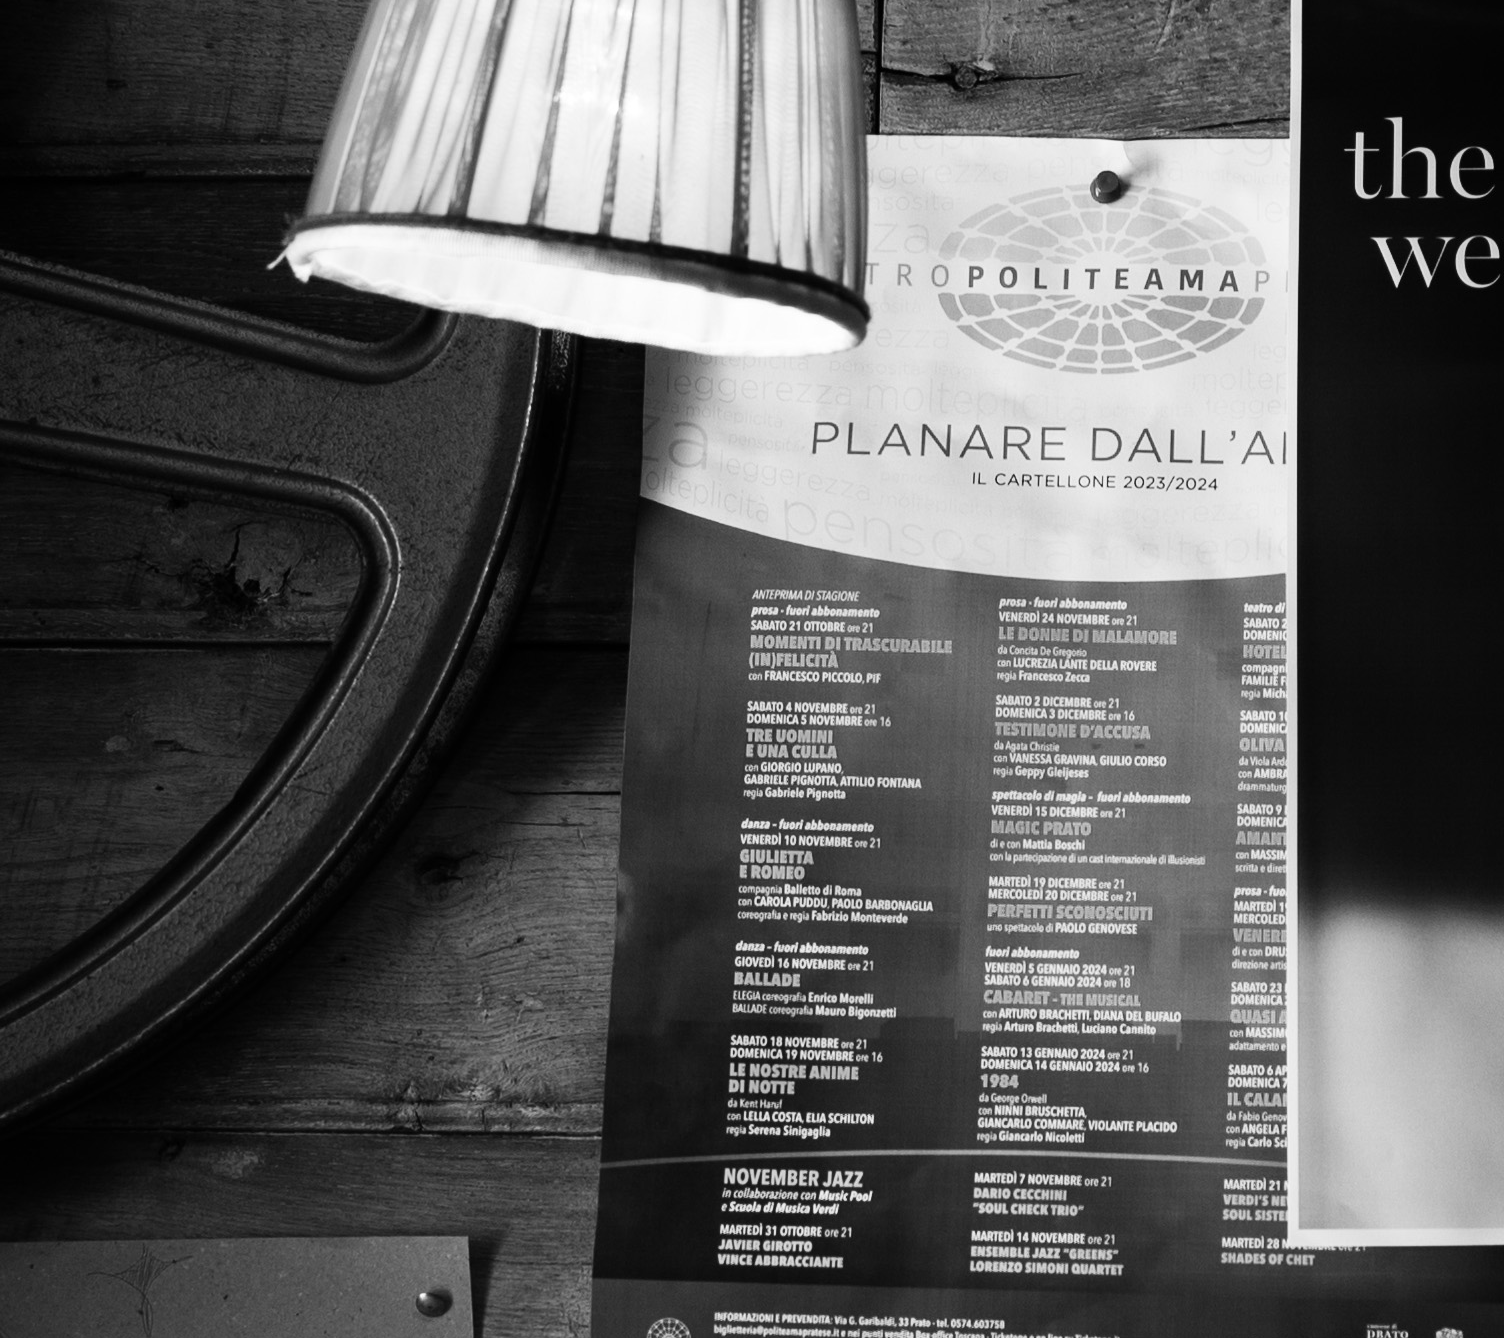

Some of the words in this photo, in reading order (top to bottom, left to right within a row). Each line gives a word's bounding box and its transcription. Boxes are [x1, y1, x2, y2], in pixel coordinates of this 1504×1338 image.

[1343, 116, 1495, 200] the
[1370, 235, 1501, 289] we
[811, 421, 1066, 461] PLANARE
[1091, 427, 1287, 465] DALL'A
[972, 471, 987, 486] IL
[994, 472, 1116, 489] CARTELLONE
[1123, 475, 1218, 492] 2023/2024
[751, 589, 803, 601] ANTEPRIMA
[804, 589, 816, 601] DI
[815, 589, 861, 602] STAGIONE
[750, 619, 788, 632] SABATO
[788, 620, 801, 632] 21
[803, 620, 846, 633] OTTOBRE
[846, 624, 861, 633] ore
[861, 622, 874, 634] 21
[750, 634, 822, 650] MOMENTI
[824, 636, 841, 651] DI
[843, 637, 953, 654] TRASCURABILE
[998, 626, 1015, 641] LE
[1017, 626, 1070, 642] DONNE
[1072, 628, 1090, 643] DI
[1092, 629, 1178, 646] MALAMORE
[745, 728, 773, 743] TRE
[775, 728, 834, 745] UOMINI
[994, 721, 1077, 739] TESTIMONE
[745, 743, 755, 758] E
[756, 743, 789, 759] UNA
[791, 744, 838, 760] CULLA
[990, 819, 1040, 836] MAGIC
[1042, 820, 1092, 837] PRATO
[739, 849, 815, 865] GIULIETTA
[739, 864, 748, 879] E
[750, 864, 806, 880] ROMEO
[987, 903, 1054, 919] PERFETTI
[1055, 904, 1153, 921] SCONOSCIUTI
[733, 971, 801, 988] BALLADE
[980, 1073, 1020, 1089] 1984
[723, 1167, 820, 1187] NOVEMBER
[822, 1170, 864, 1188] JAZZ
